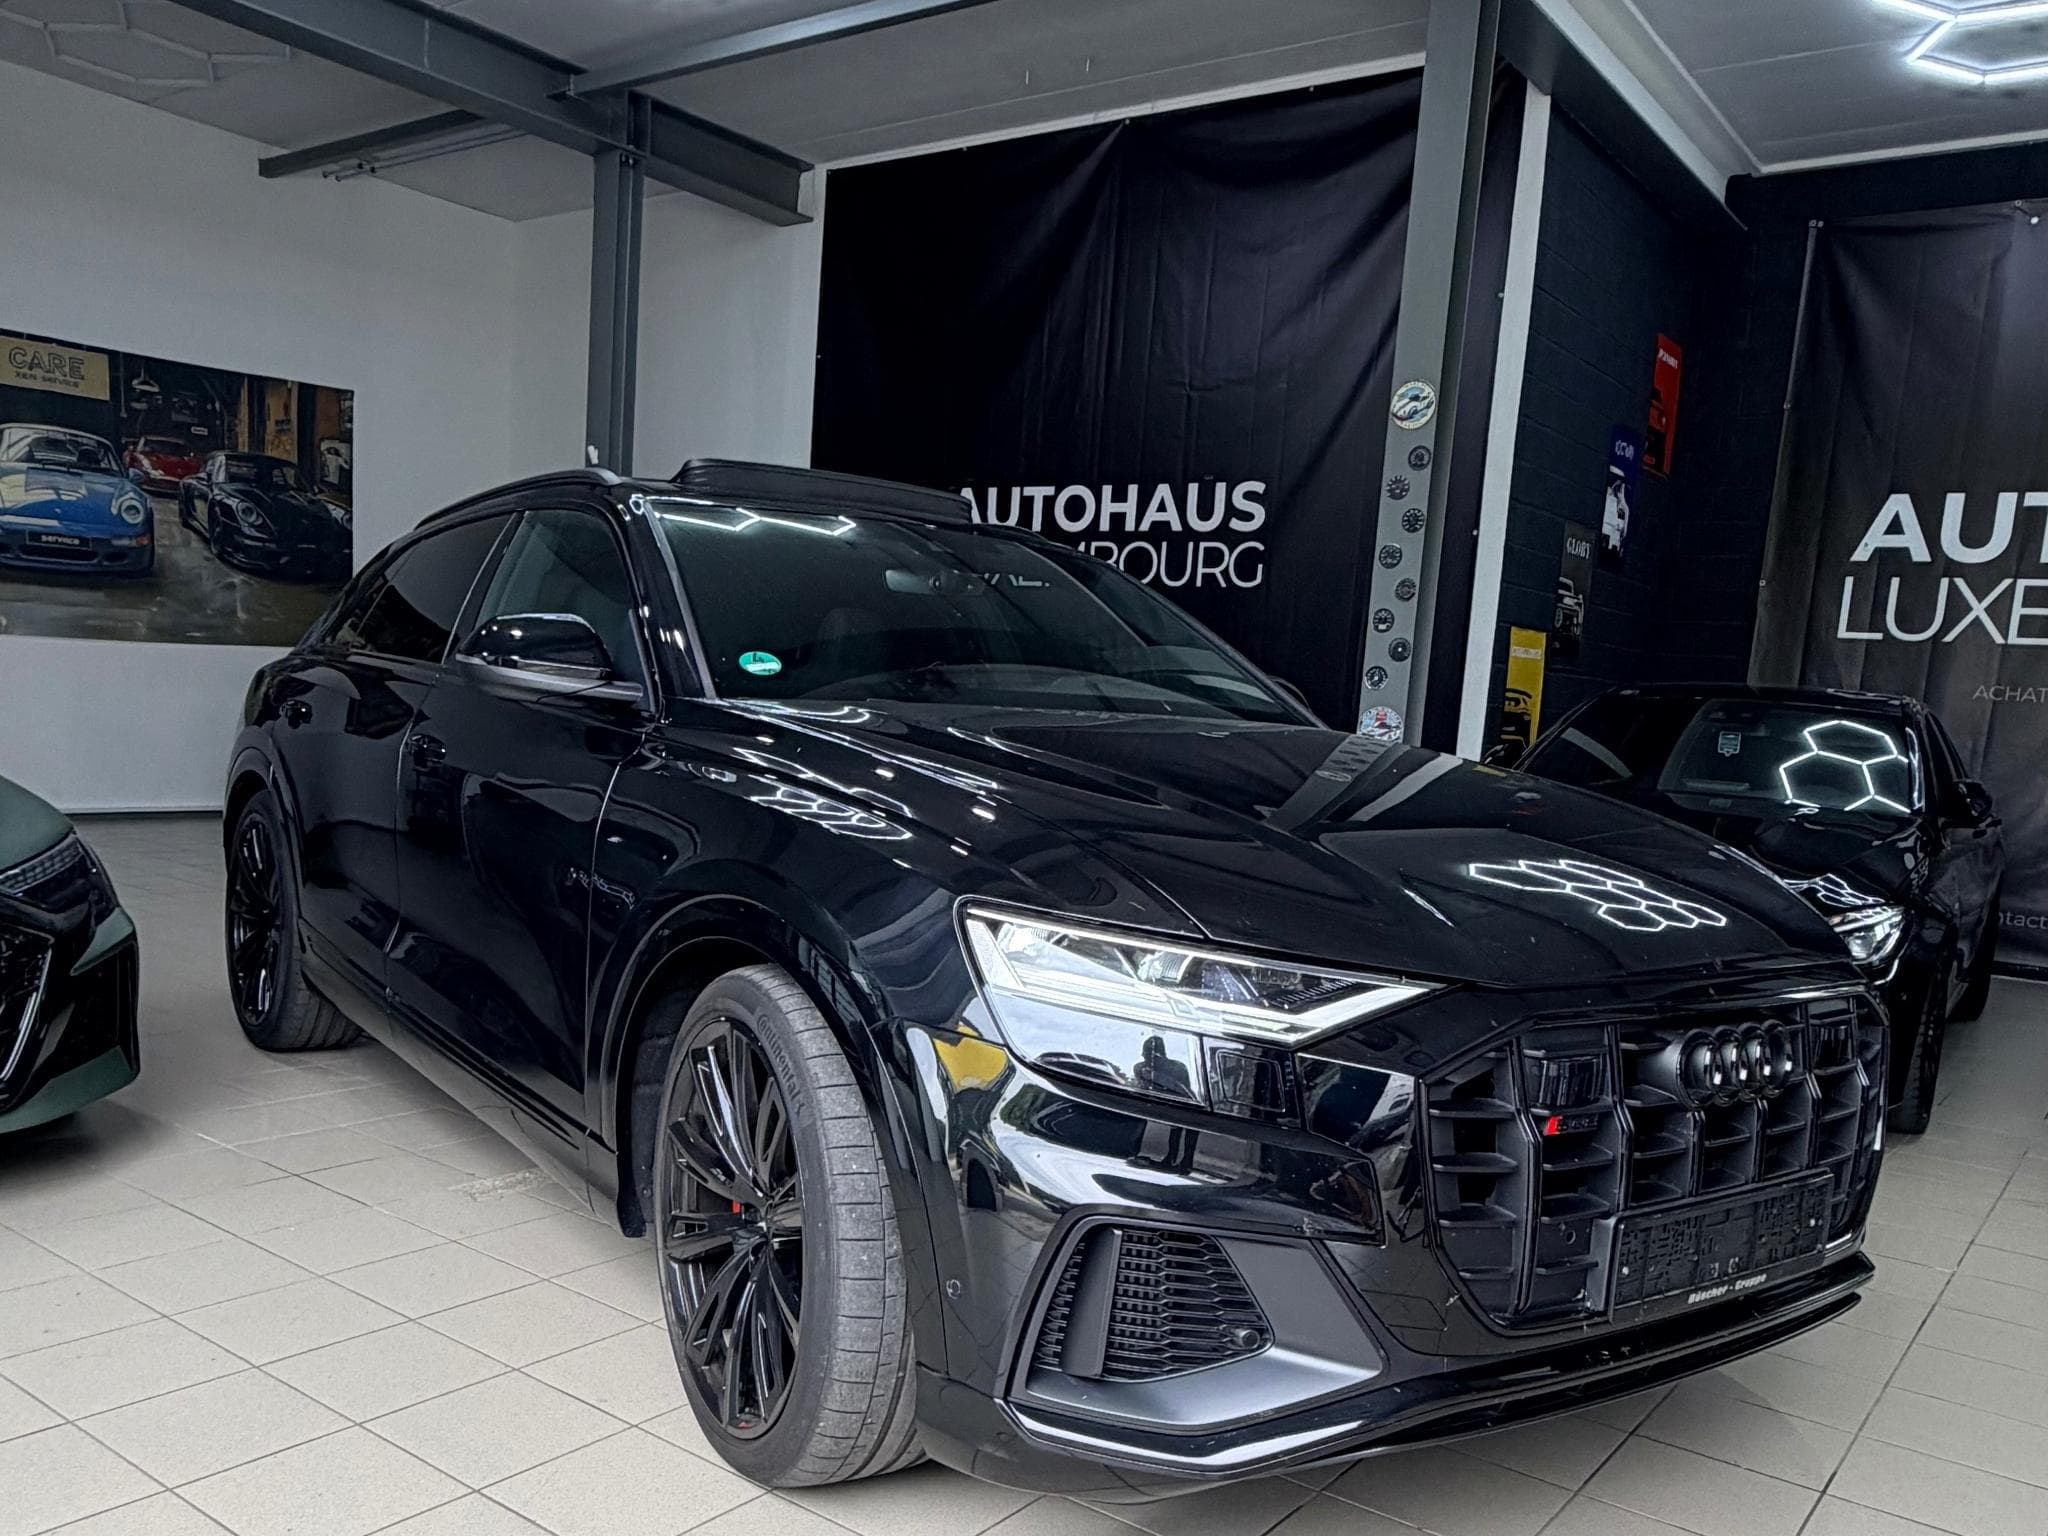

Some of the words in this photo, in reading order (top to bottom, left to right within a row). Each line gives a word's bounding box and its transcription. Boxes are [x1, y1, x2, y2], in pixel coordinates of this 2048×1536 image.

[8, 346, 85, 380] CARE
[1078, 541, 1265, 588] OURG
[1837, 576, 2048, 646] LUXE
[1972, 684, 2048, 704] ACHAT
